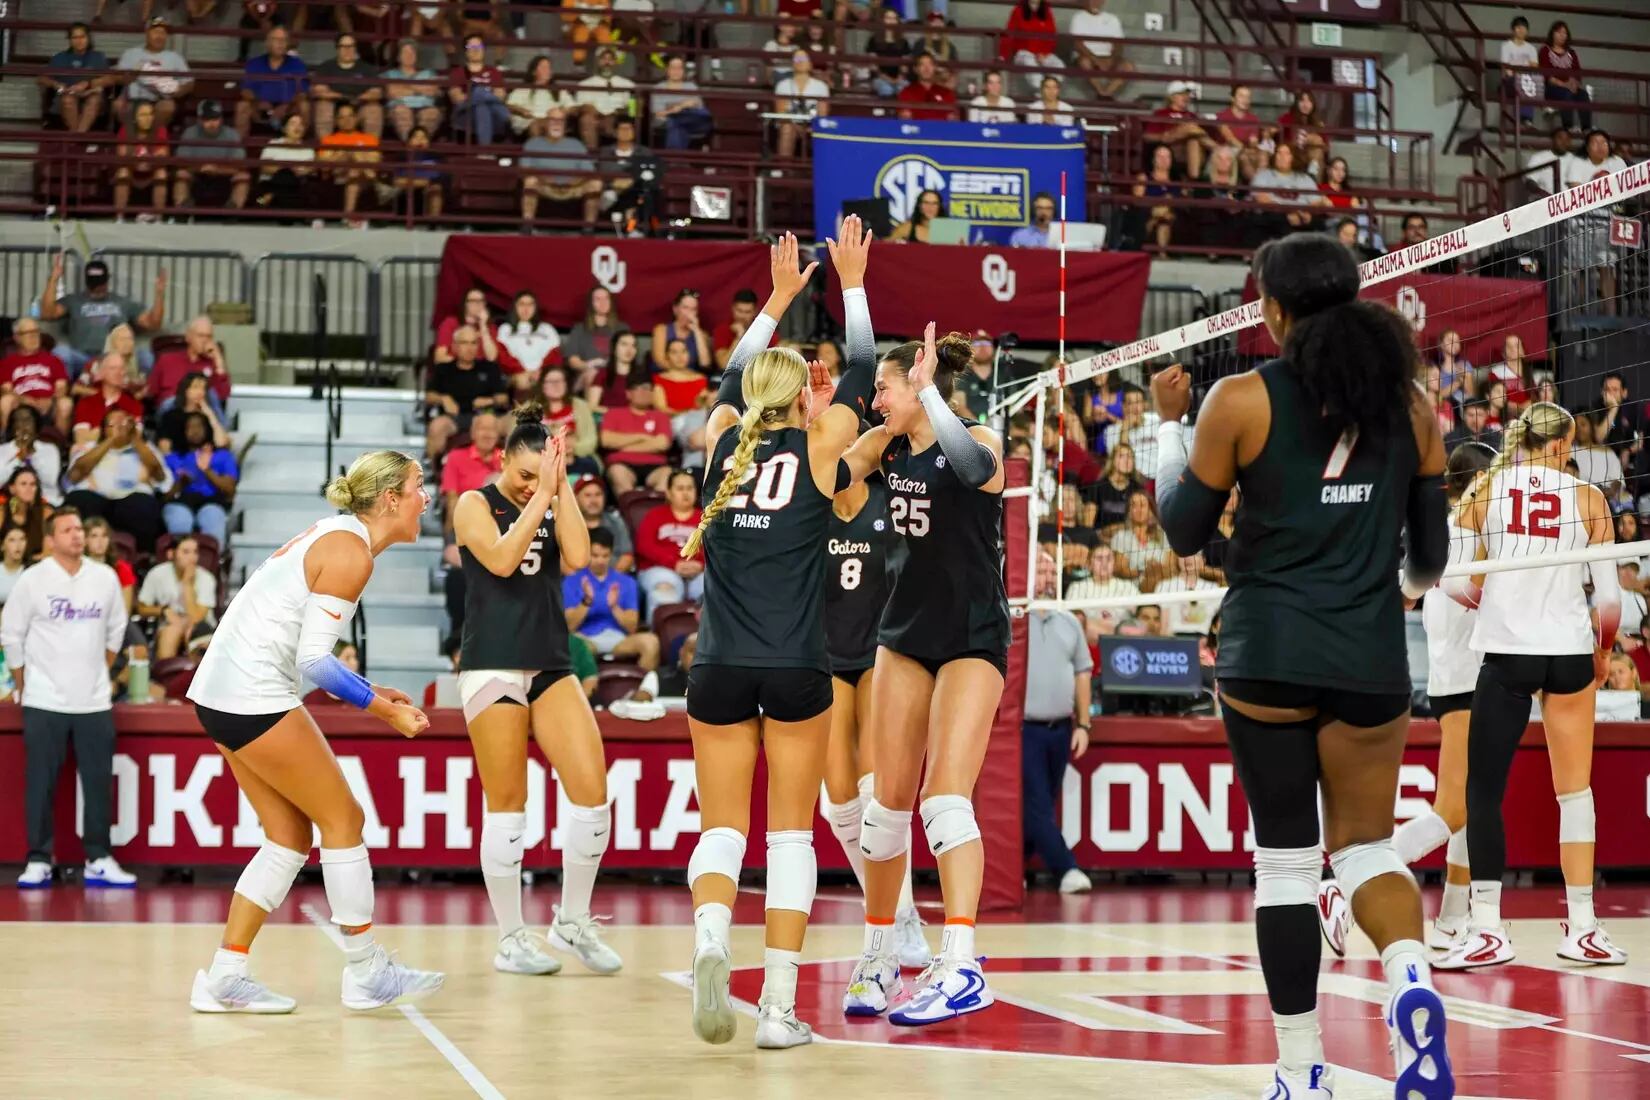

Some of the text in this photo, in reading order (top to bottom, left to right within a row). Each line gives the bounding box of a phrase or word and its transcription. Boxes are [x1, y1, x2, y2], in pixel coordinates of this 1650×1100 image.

[949, 173, 1021, 195] ESPN
[1547, 176, 1612, 218] OKLAHOMA
[949, 201, 1022, 219] NETWORK
[588, 246, 626, 293] OU
[1359, 229, 1468, 283] KLAHOMA VOLLEYBALL
[982, 254, 1016, 301] OU
[1207, 307, 1246, 334] OKLAHOMA
[721, 451, 800, 511] 20
[888, 472, 927, 494] Gators
[1320, 483, 1374, 504] CHANEY
[732, 513, 771, 529] PARKS
[890, 496, 931, 537] 25
[1507, 488, 1561, 538] 12
[520, 541, 543, 576] 5
[828, 538, 871, 555] Gators
[840, 558, 862, 590] 8
[1145, 651, 1188, 664] VIDEO
[1146, 664, 1189, 675] REVIEW
